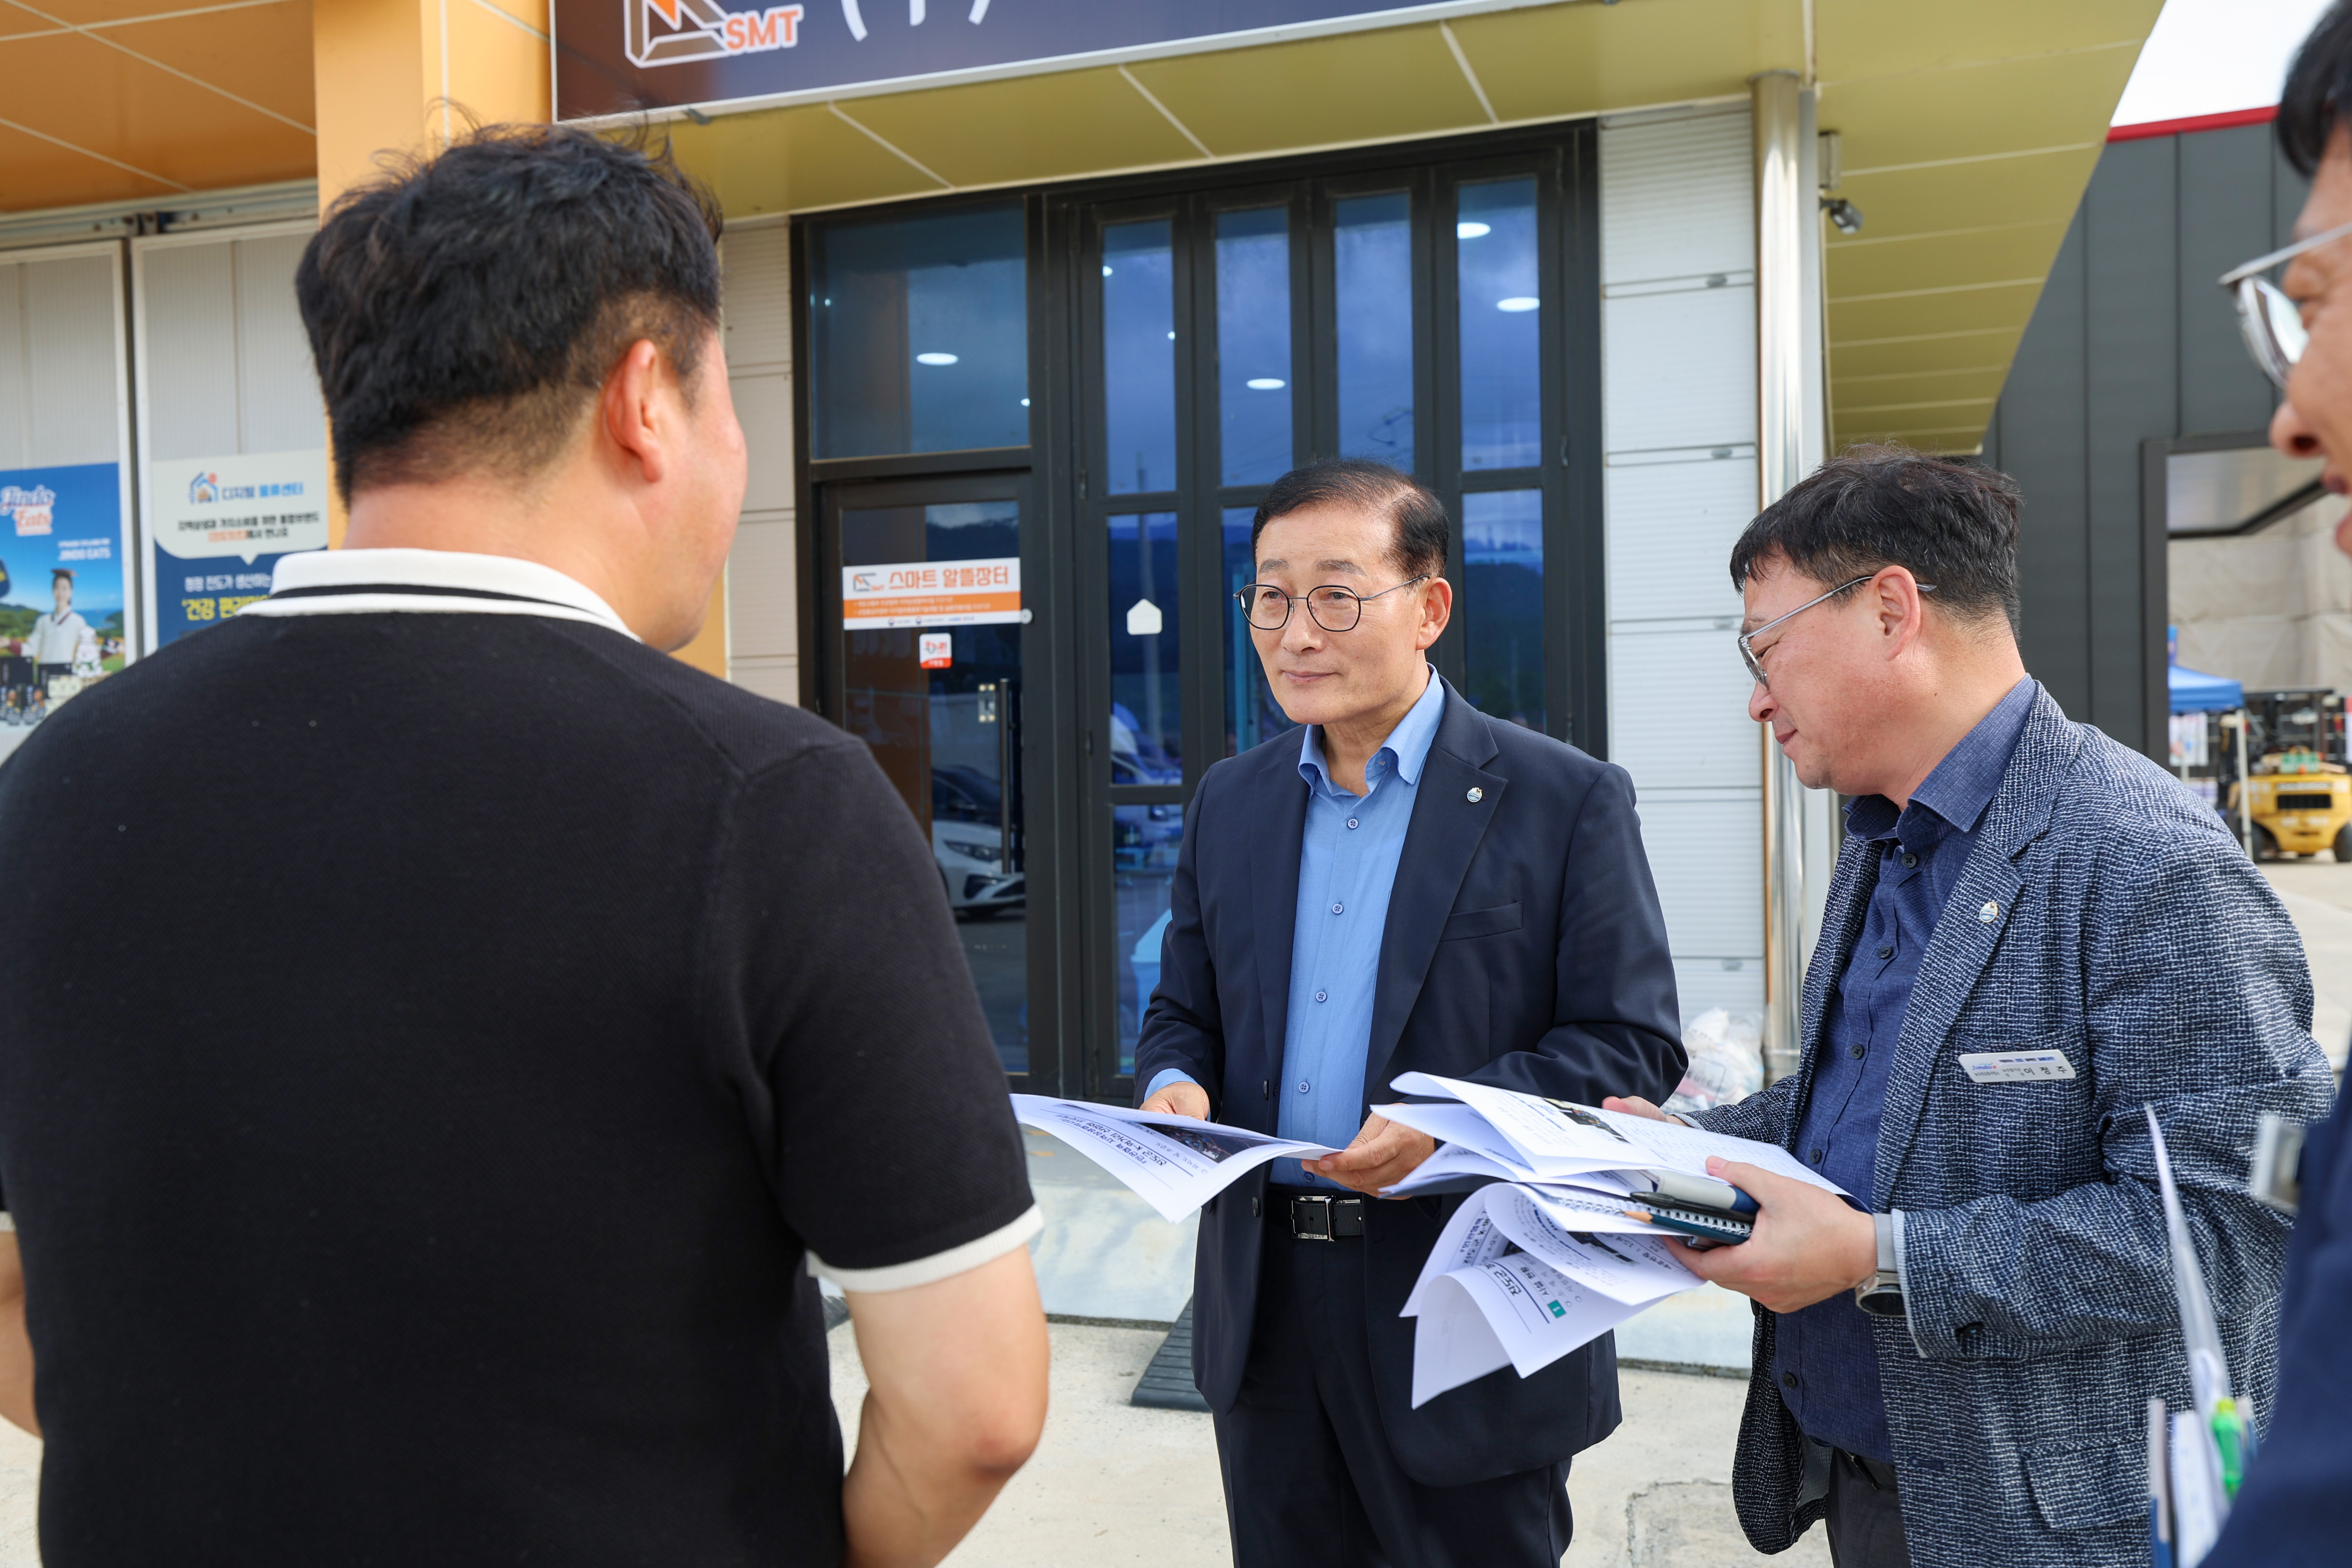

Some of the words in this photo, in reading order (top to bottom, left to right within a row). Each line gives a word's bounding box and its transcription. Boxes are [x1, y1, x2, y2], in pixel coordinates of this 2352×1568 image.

[725, 9, 800, 50] SMT
[222, 486, 254, 500] 디지털
[259, 482, 303, 498] 물류센터
[889, 570, 937, 590] 스마트
[943, 566, 1009, 588] 알뜰장터
[1142, 1151, 1167, 1167] 진도군
[1520, 1267, 1535, 1279] 현황
[1494, 1269, 1522, 1296] 진도군
[1534, 1281, 1549, 1296] 시설
